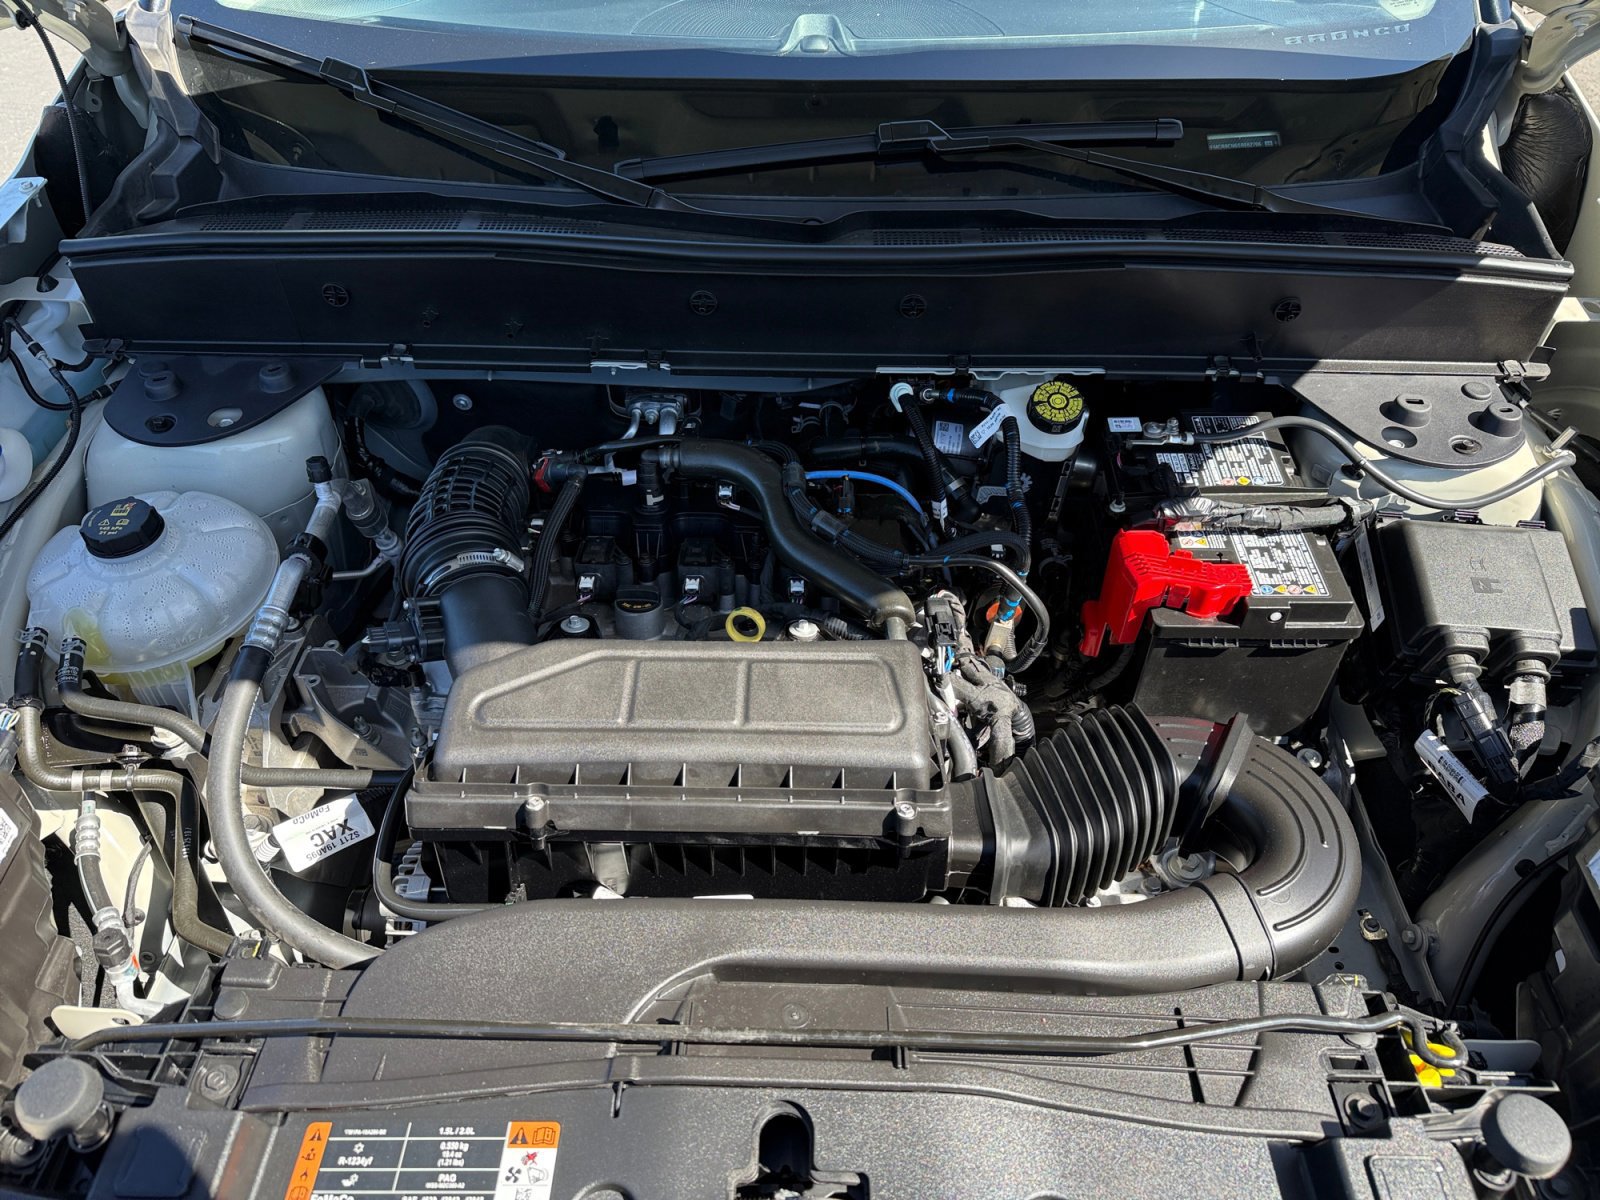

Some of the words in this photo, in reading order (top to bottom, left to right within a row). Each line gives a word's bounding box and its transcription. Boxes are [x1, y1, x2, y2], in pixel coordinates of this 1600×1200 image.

[1283, 23, 1410, 46] BRONCO
[292, 804, 331, 825] FoMoCo
[310, 818, 354, 848] XAC
[339, 830, 361, 846] SZ1T
[439, 1126, 454, 1136] 1.5L
[459, 1126, 476, 1136] 2.0L
[459, 1141, 470, 1153] kg
[438, 1173, 457, 1182] PAG
